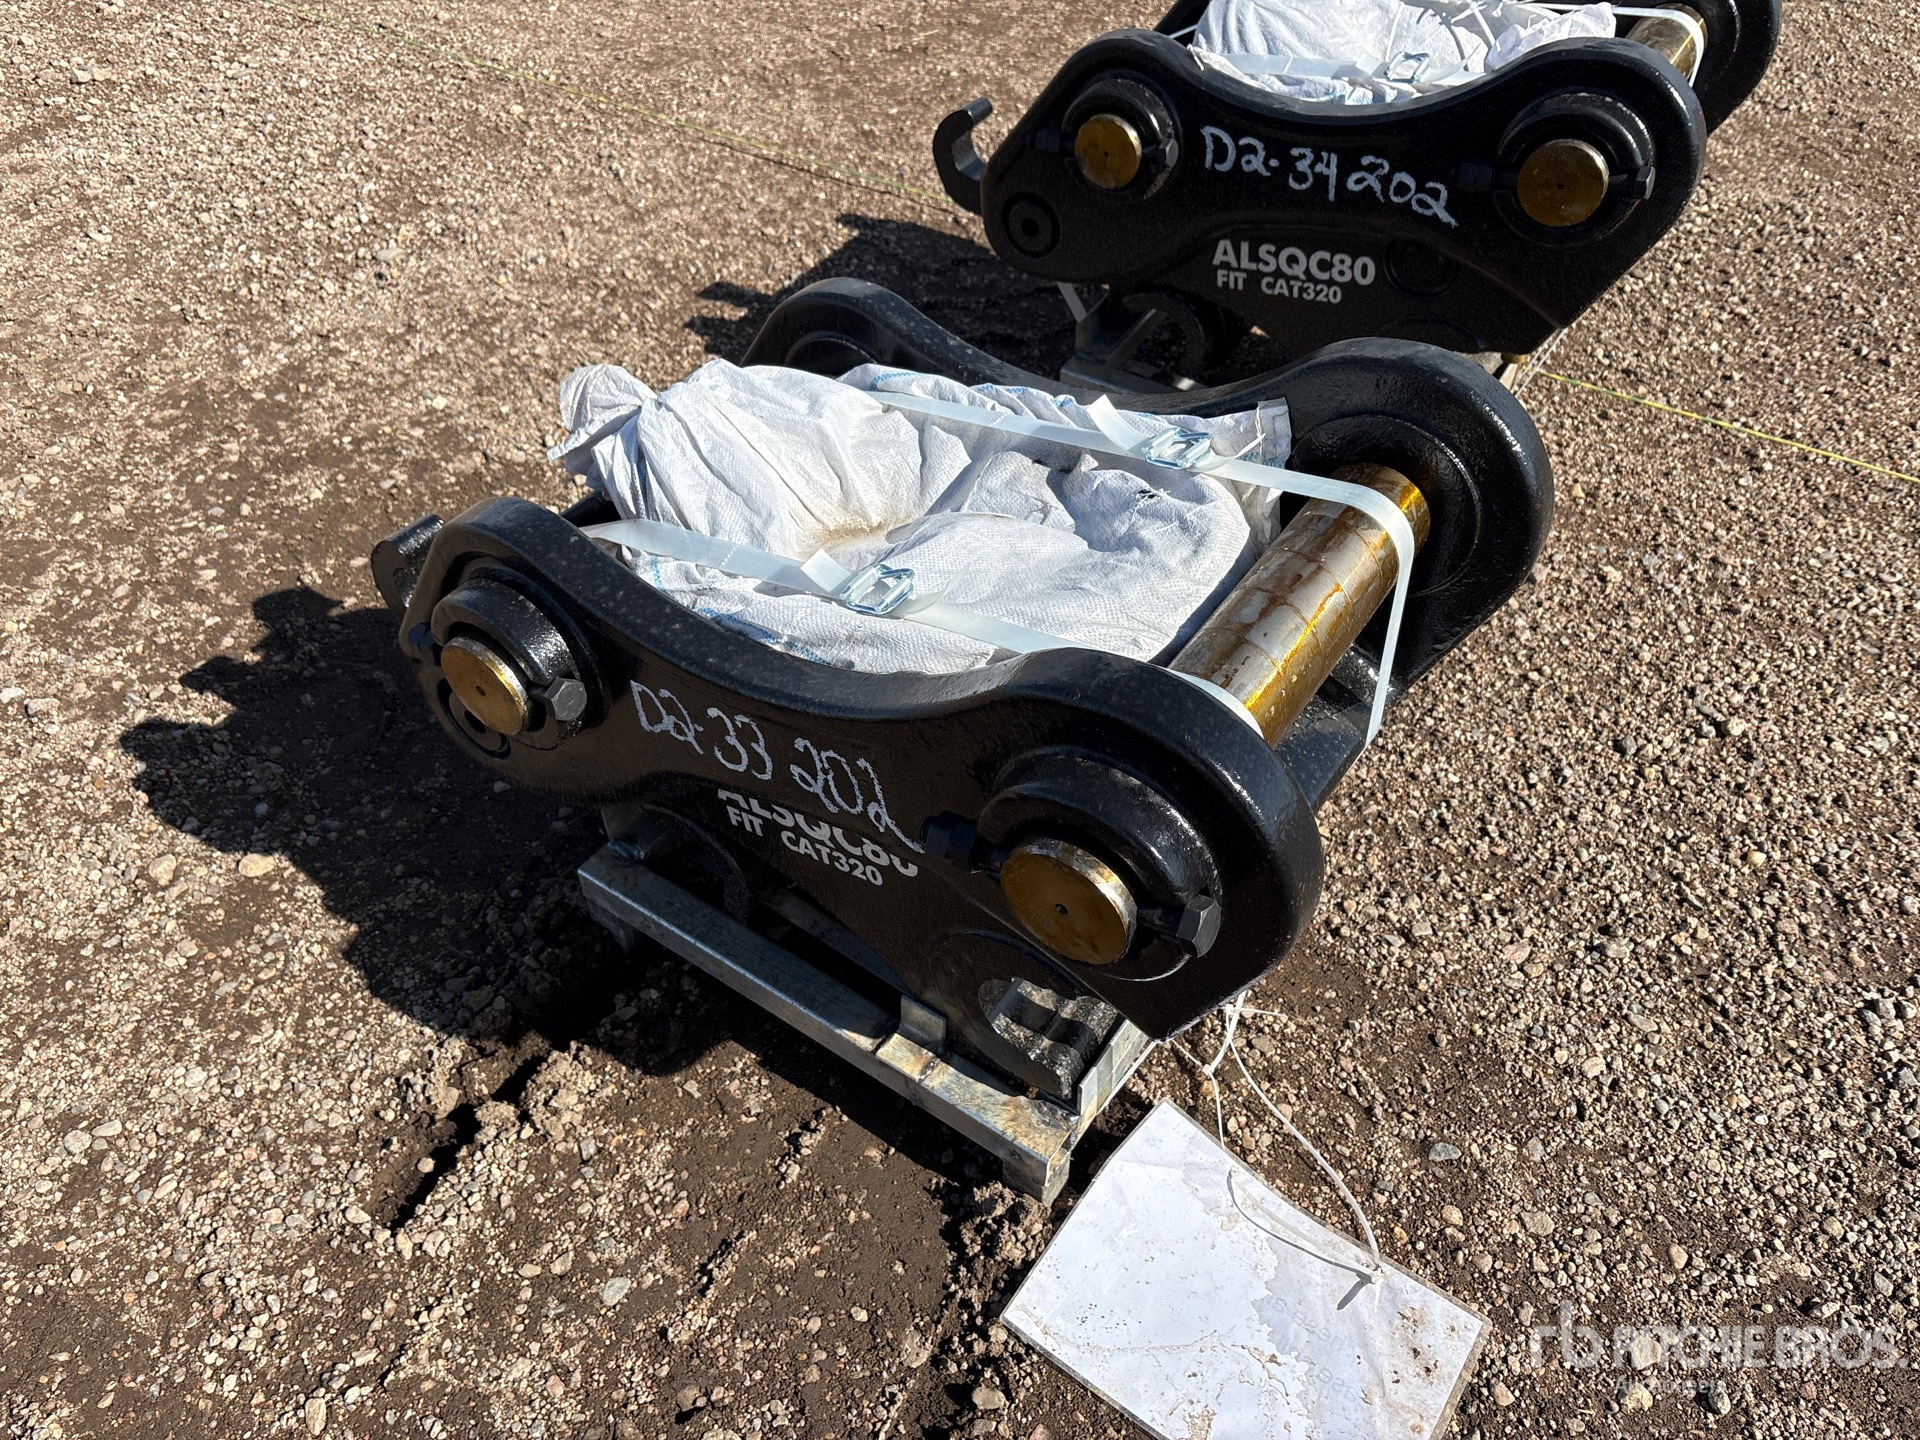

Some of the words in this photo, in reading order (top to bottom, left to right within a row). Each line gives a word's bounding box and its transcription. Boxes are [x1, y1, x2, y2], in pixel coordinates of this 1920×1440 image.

[1346, 155, 1459, 229] 202
[1212, 239, 1376, 286] ALSQC80
[1216, 269, 1247, 290] FIT
[1260, 276, 1342, 304] CAT320
[790, 737, 925, 854] 202
[726, 805, 764, 837] FIT
[781, 830, 884, 886] CAT320
